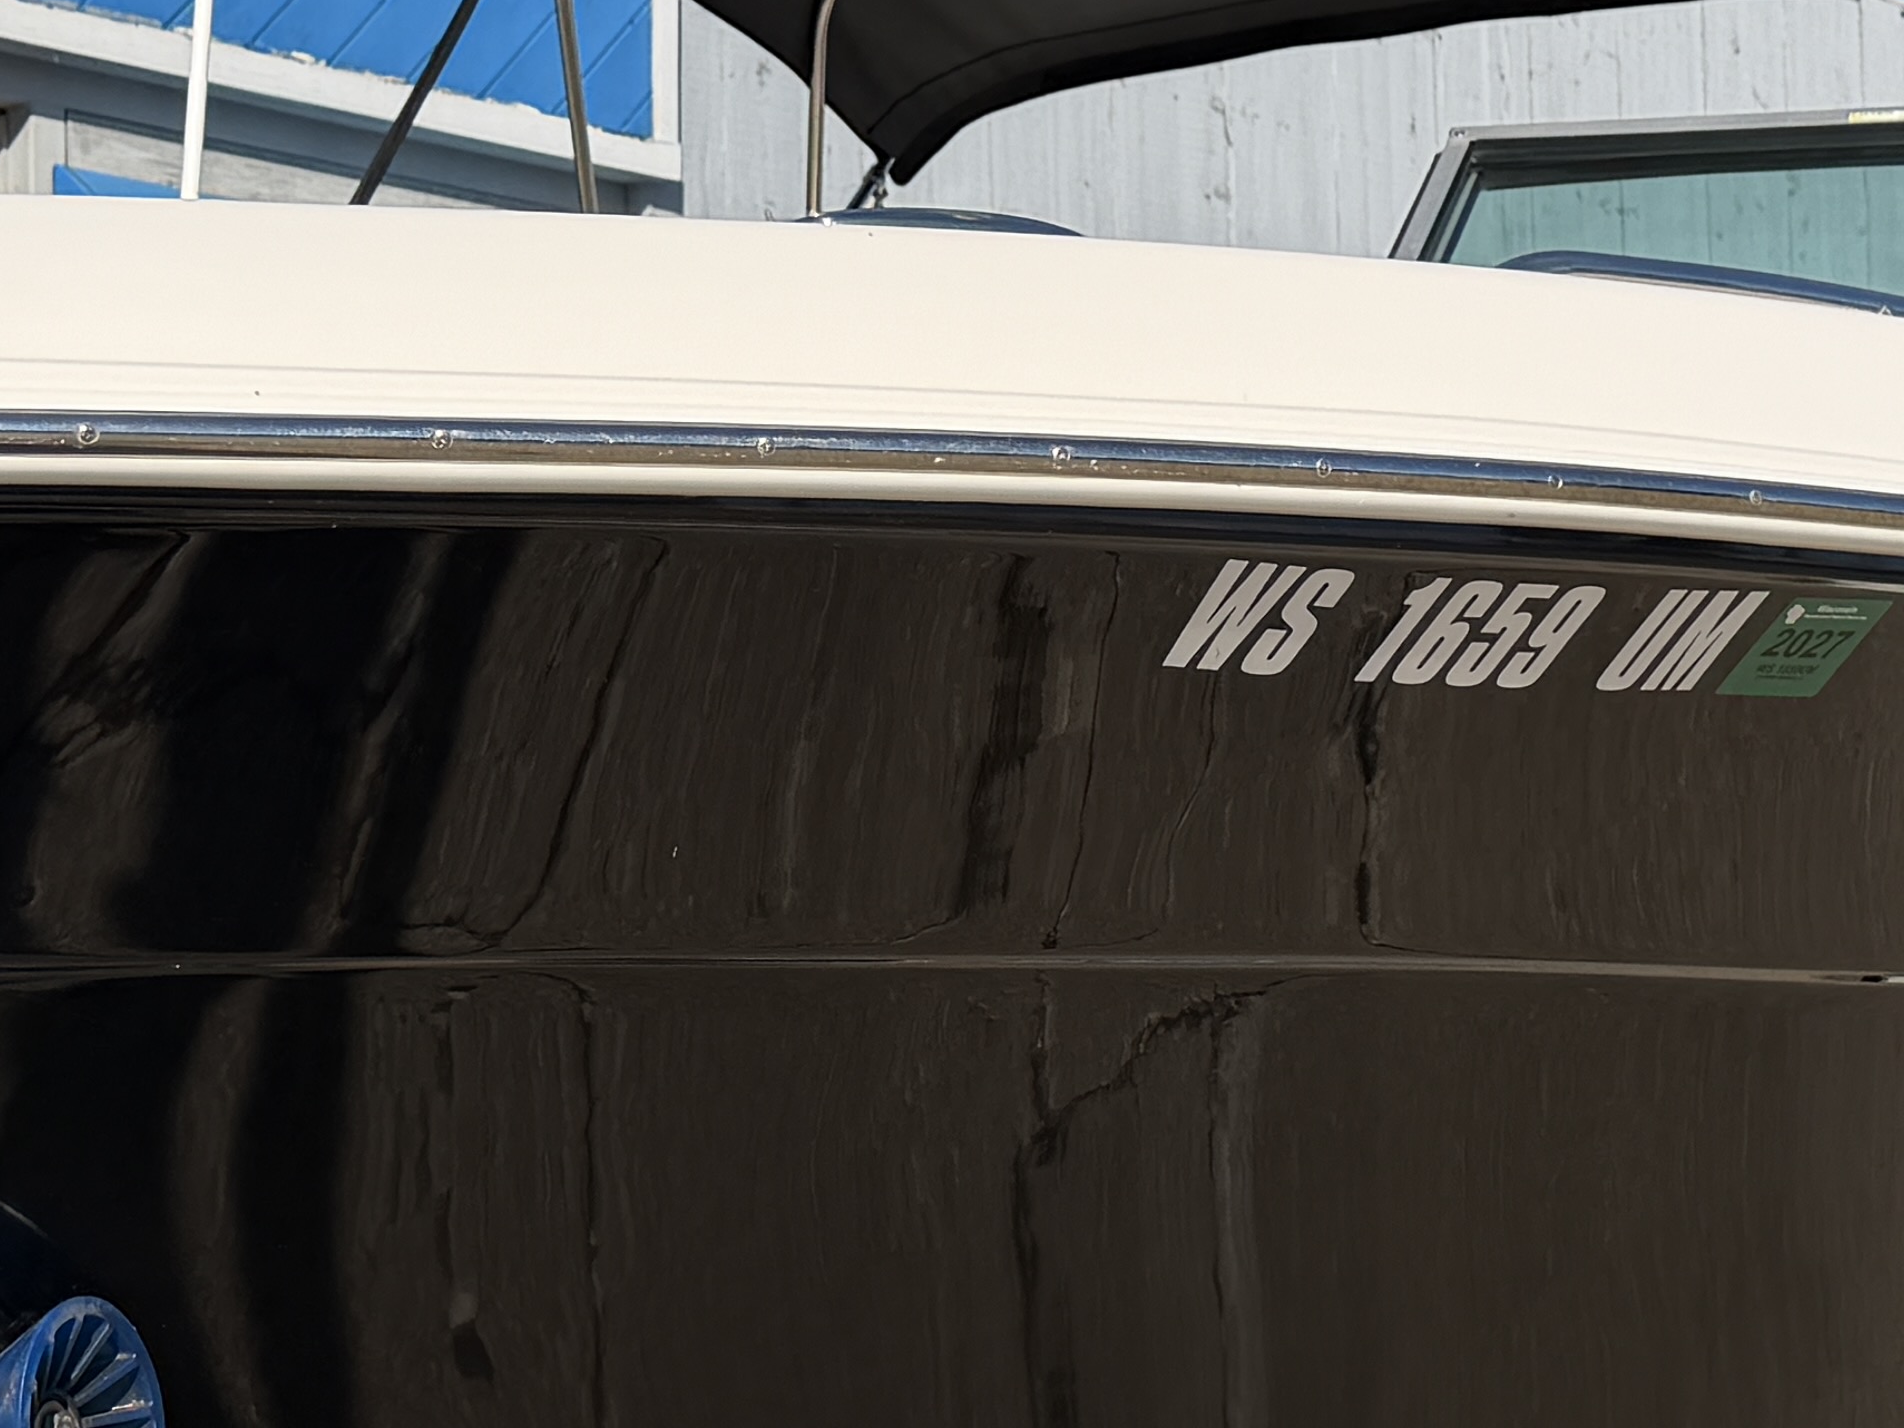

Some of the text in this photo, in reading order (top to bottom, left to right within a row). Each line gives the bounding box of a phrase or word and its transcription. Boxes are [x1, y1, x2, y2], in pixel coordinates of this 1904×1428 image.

[1162, 557, 1771, 692] WS 1659 UM
[1759, 627, 1857, 660] 2027
